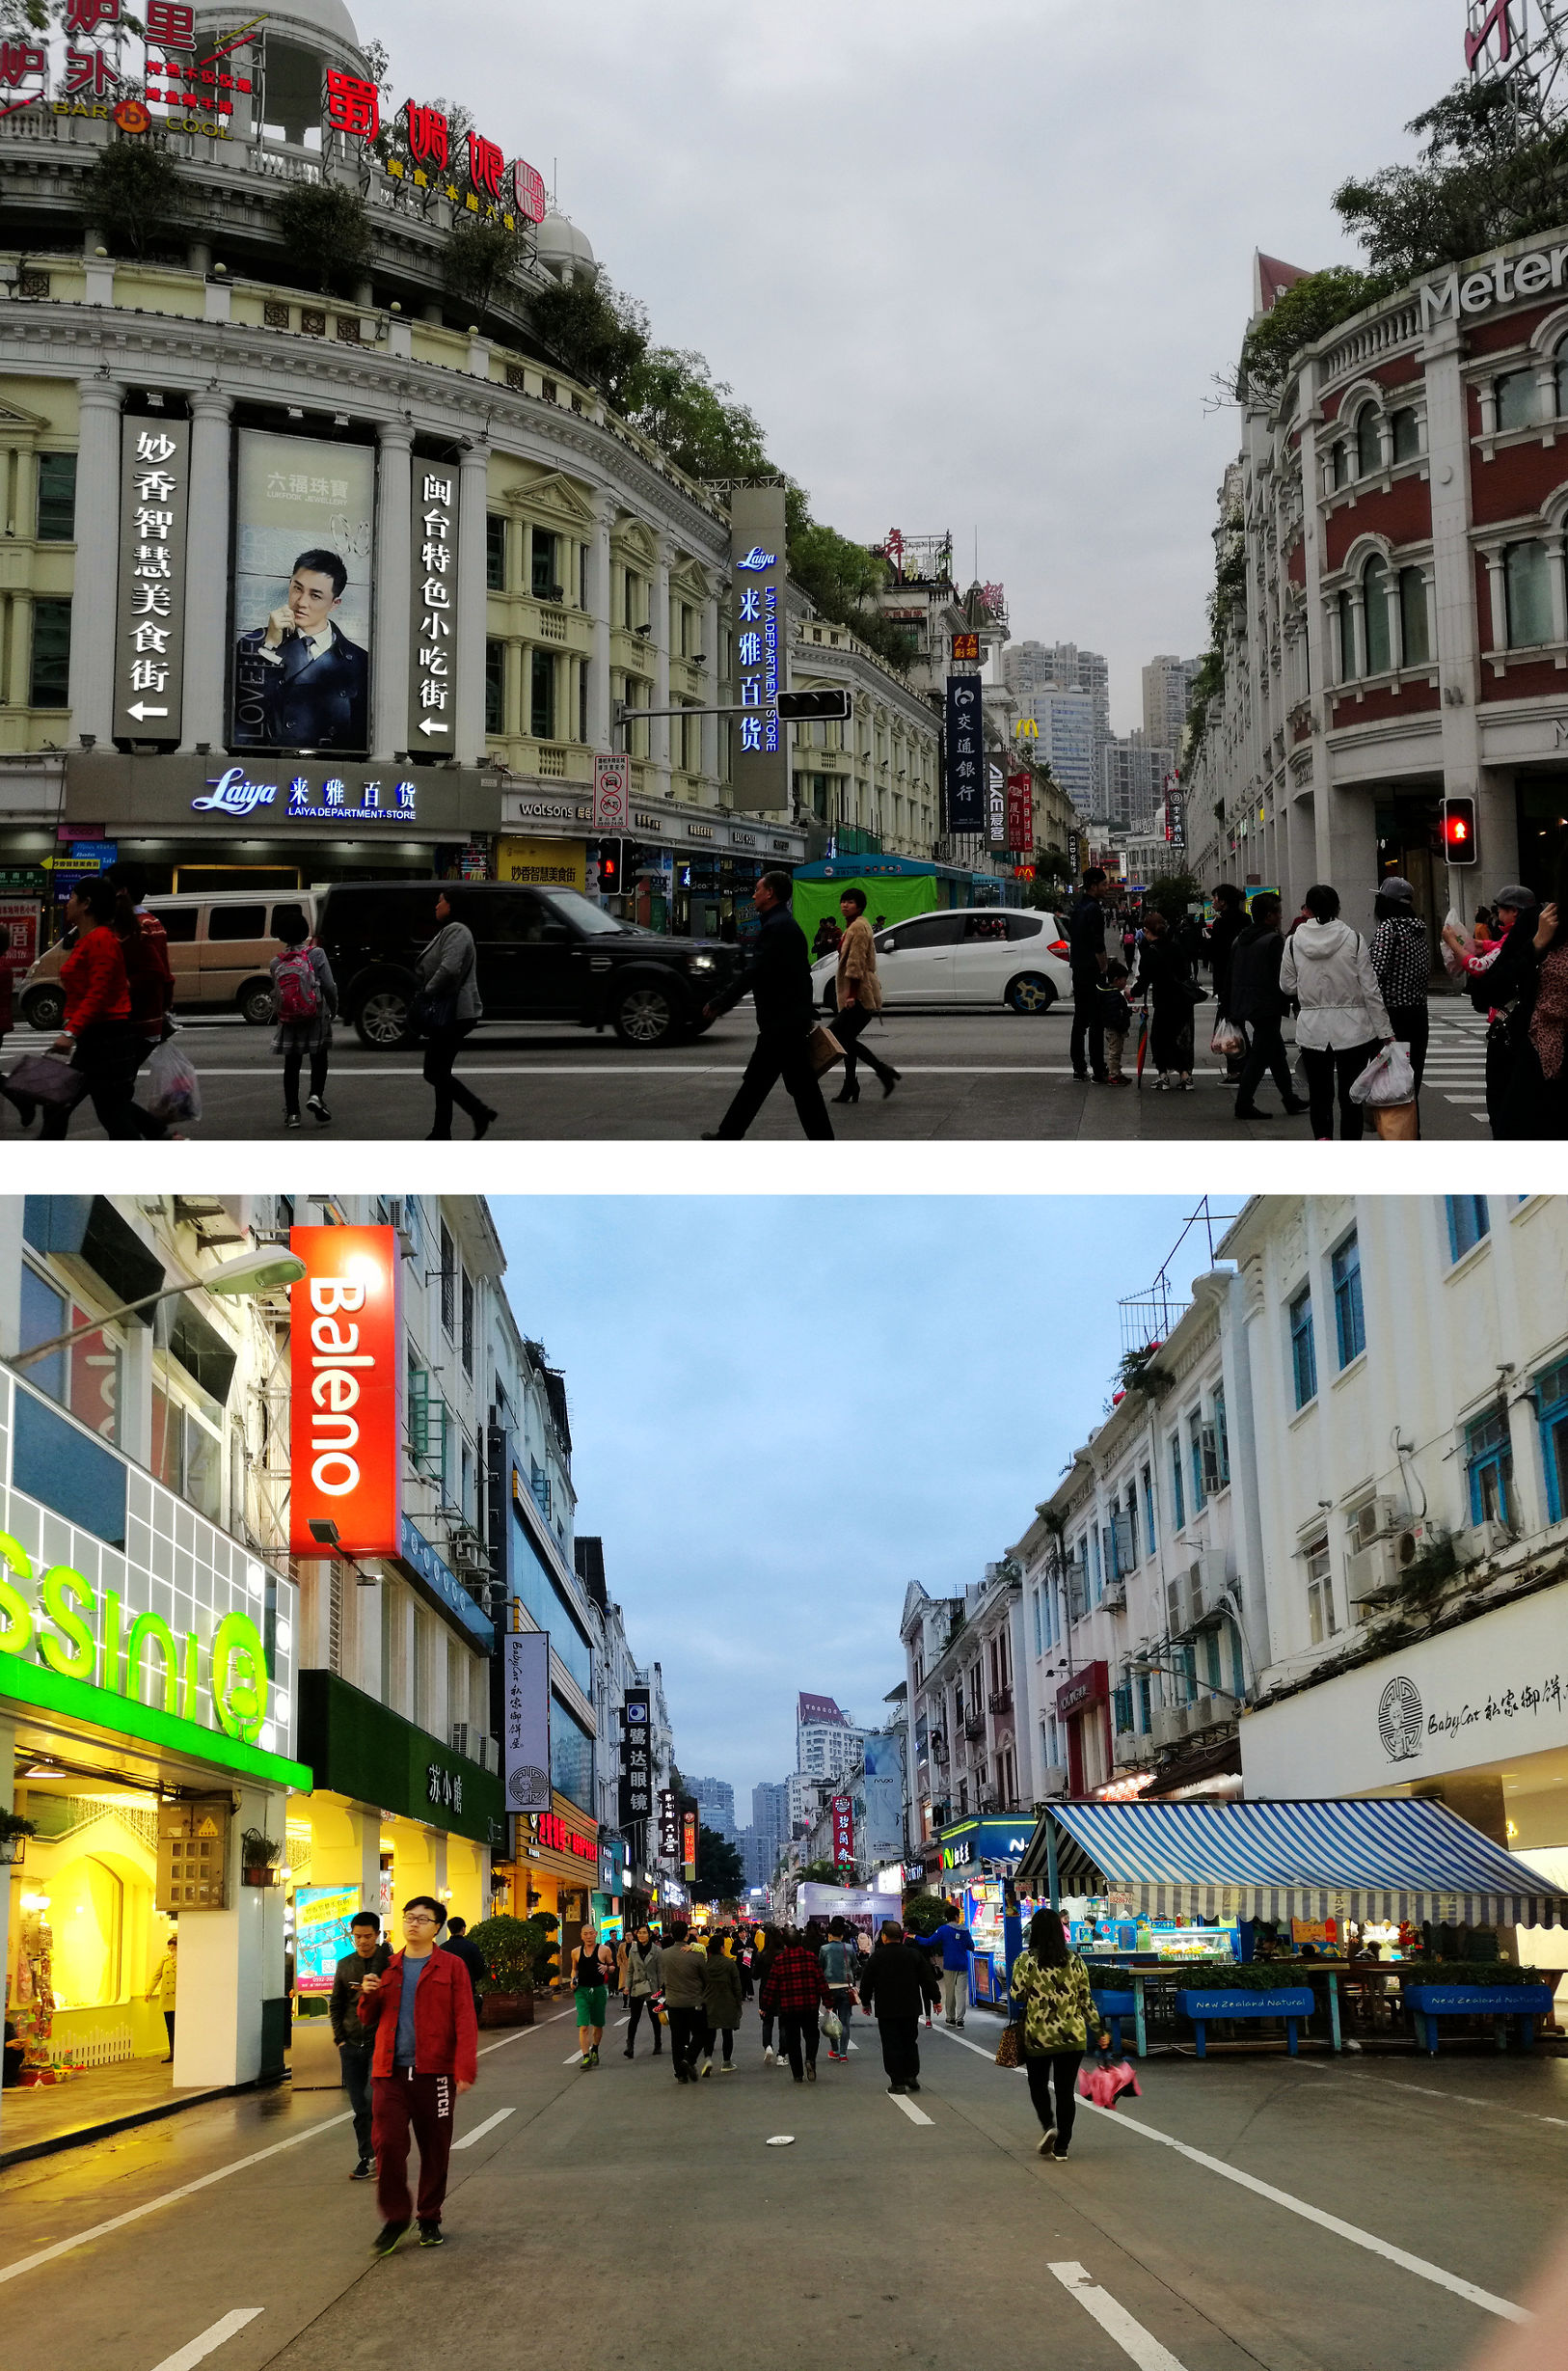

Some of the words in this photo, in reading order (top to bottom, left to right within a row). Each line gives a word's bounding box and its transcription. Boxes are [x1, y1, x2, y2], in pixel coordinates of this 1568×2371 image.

[53, 101, 108, 120] BAR
[165, 117, 234, 141] COOL
[267, 472, 349, 500] 六福珠寶
[129, 431, 177, 694] 妙香智慧美食街
[737, 546, 776, 570] Laiya
[419, 473, 452, 711] 闽台特色小吃街
[765, 586, 777, 622] LAIYA
[738, 587, 762, 751] 来雅百货
[765, 623, 777, 705] DEPARTMENT
[237, 668, 265, 739] LOVE
[766, 710, 777, 751] STORE
[955, 713, 976, 803] 交通銀行
[192, 766, 278, 816] Laiya
[289, 777, 417, 809] 来雅百货
[288, 806, 317, 817] LAIYA
[317, 807, 384, 819] DEPARTMENT
[385, 809, 417, 820] STORE
[520, 804, 574, 819] watsons
[511, 865, 577, 883] 妙香智慧美食街
[310, 1276, 376, 1497] Baleno
[1196, 2001, 1218, 2009] New
[1221, 1998, 1265, 2009] Zealand
[1267, 1998, 1306, 2007] Natural
[1457, 1996, 1501, 2004] Zealand
[436, 2075, 448, 2118] FITCH
